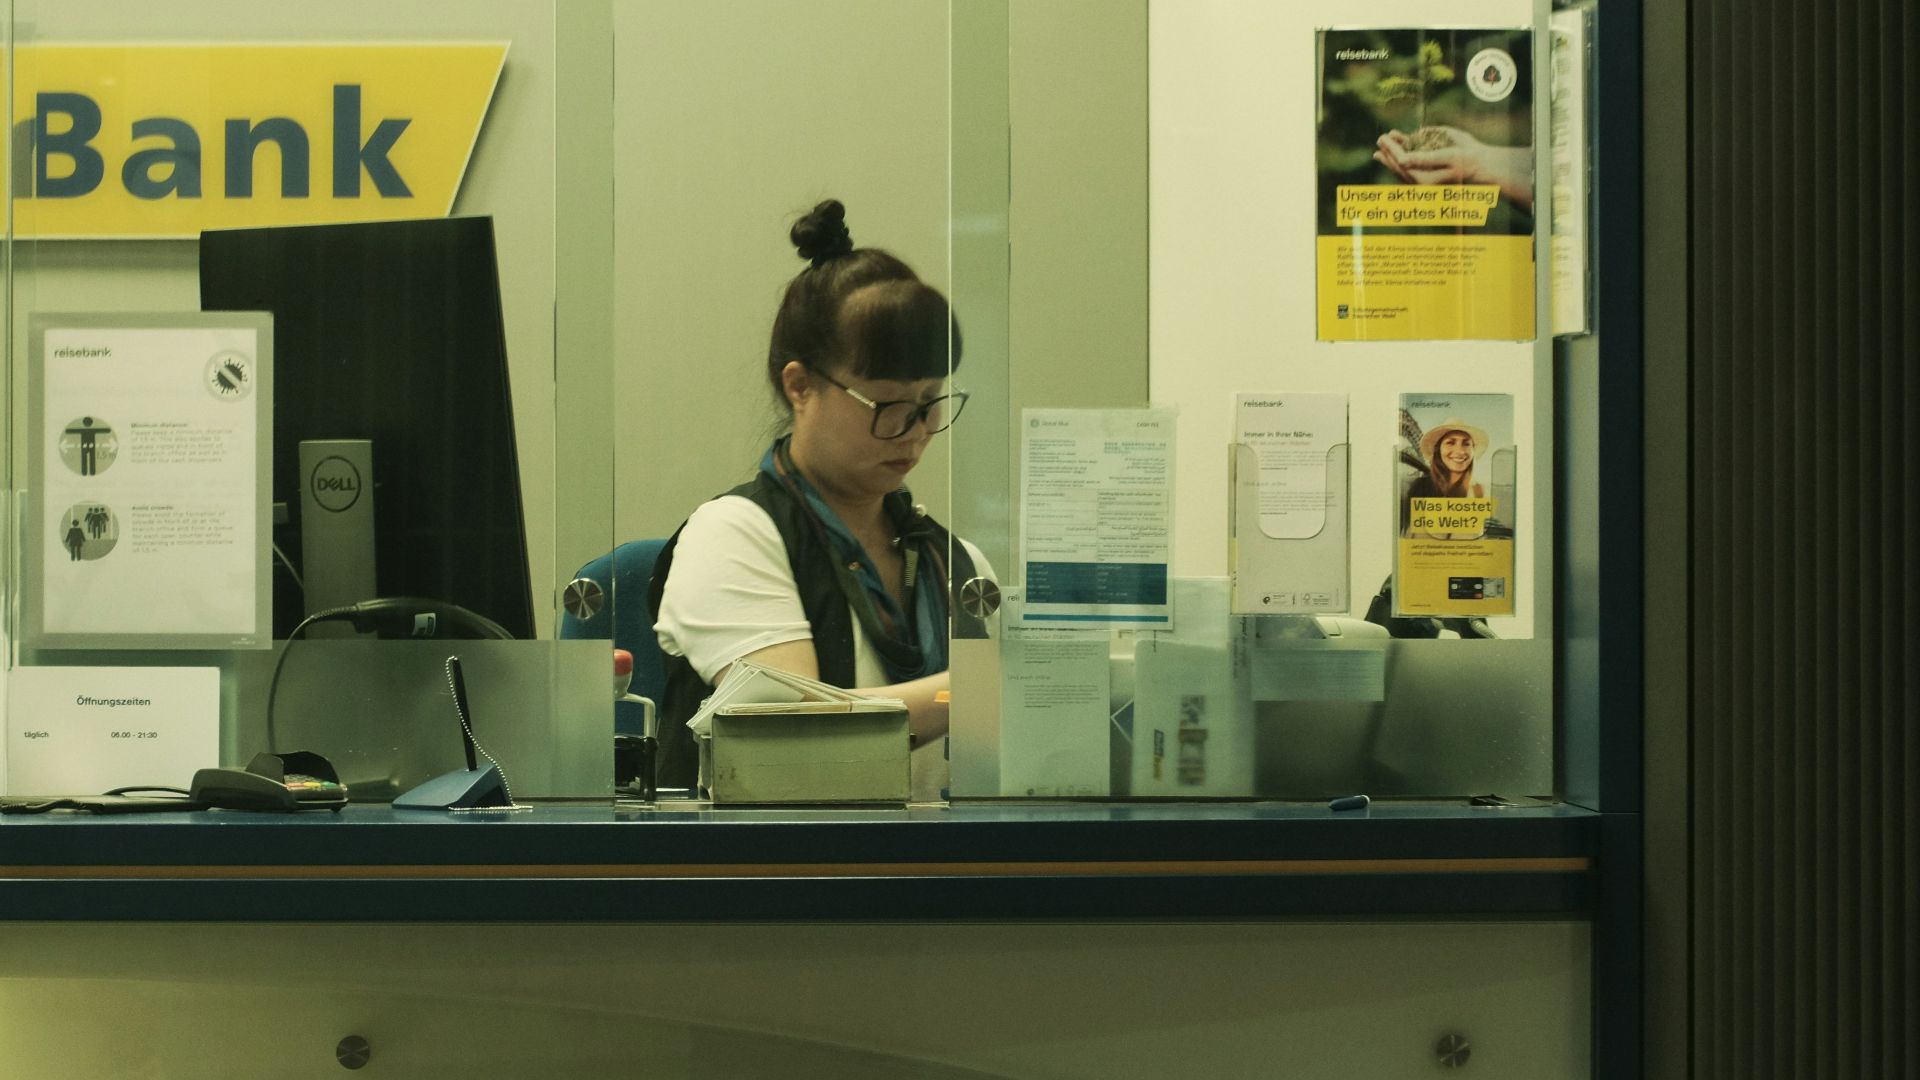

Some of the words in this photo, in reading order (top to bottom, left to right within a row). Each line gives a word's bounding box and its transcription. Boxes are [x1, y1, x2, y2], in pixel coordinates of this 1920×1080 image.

[1336, 48, 1389, 60] reisebank
[36, 84, 415, 200] Bank
[1340, 189, 1382, 201] Unser
[1387, 189, 1437, 201] aktiver
[1443, 188, 1495, 204] Beitrag
[1341, 207, 1361, 220] für
[1366, 208, 1388, 220] ein
[1393, 208, 1436, 222] gutes
[1440, 207, 1483, 220] Klima.
[54, 346, 112, 359] reisebank
[1244, 400, 1284, 408] reisebank
[1411, 401, 1451, 409] reisebank
[317, 477, 356, 491] DELL
[1413, 500, 1442, 512] Was
[1447, 500, 1492, 512] kostet
[1413, 516, 1434, 528] die
[1439, 516, 1478, 528] Welt?
[76, 695, 151, 707] Öffnungszeiten
[24, 731, 49, 740] täglich
